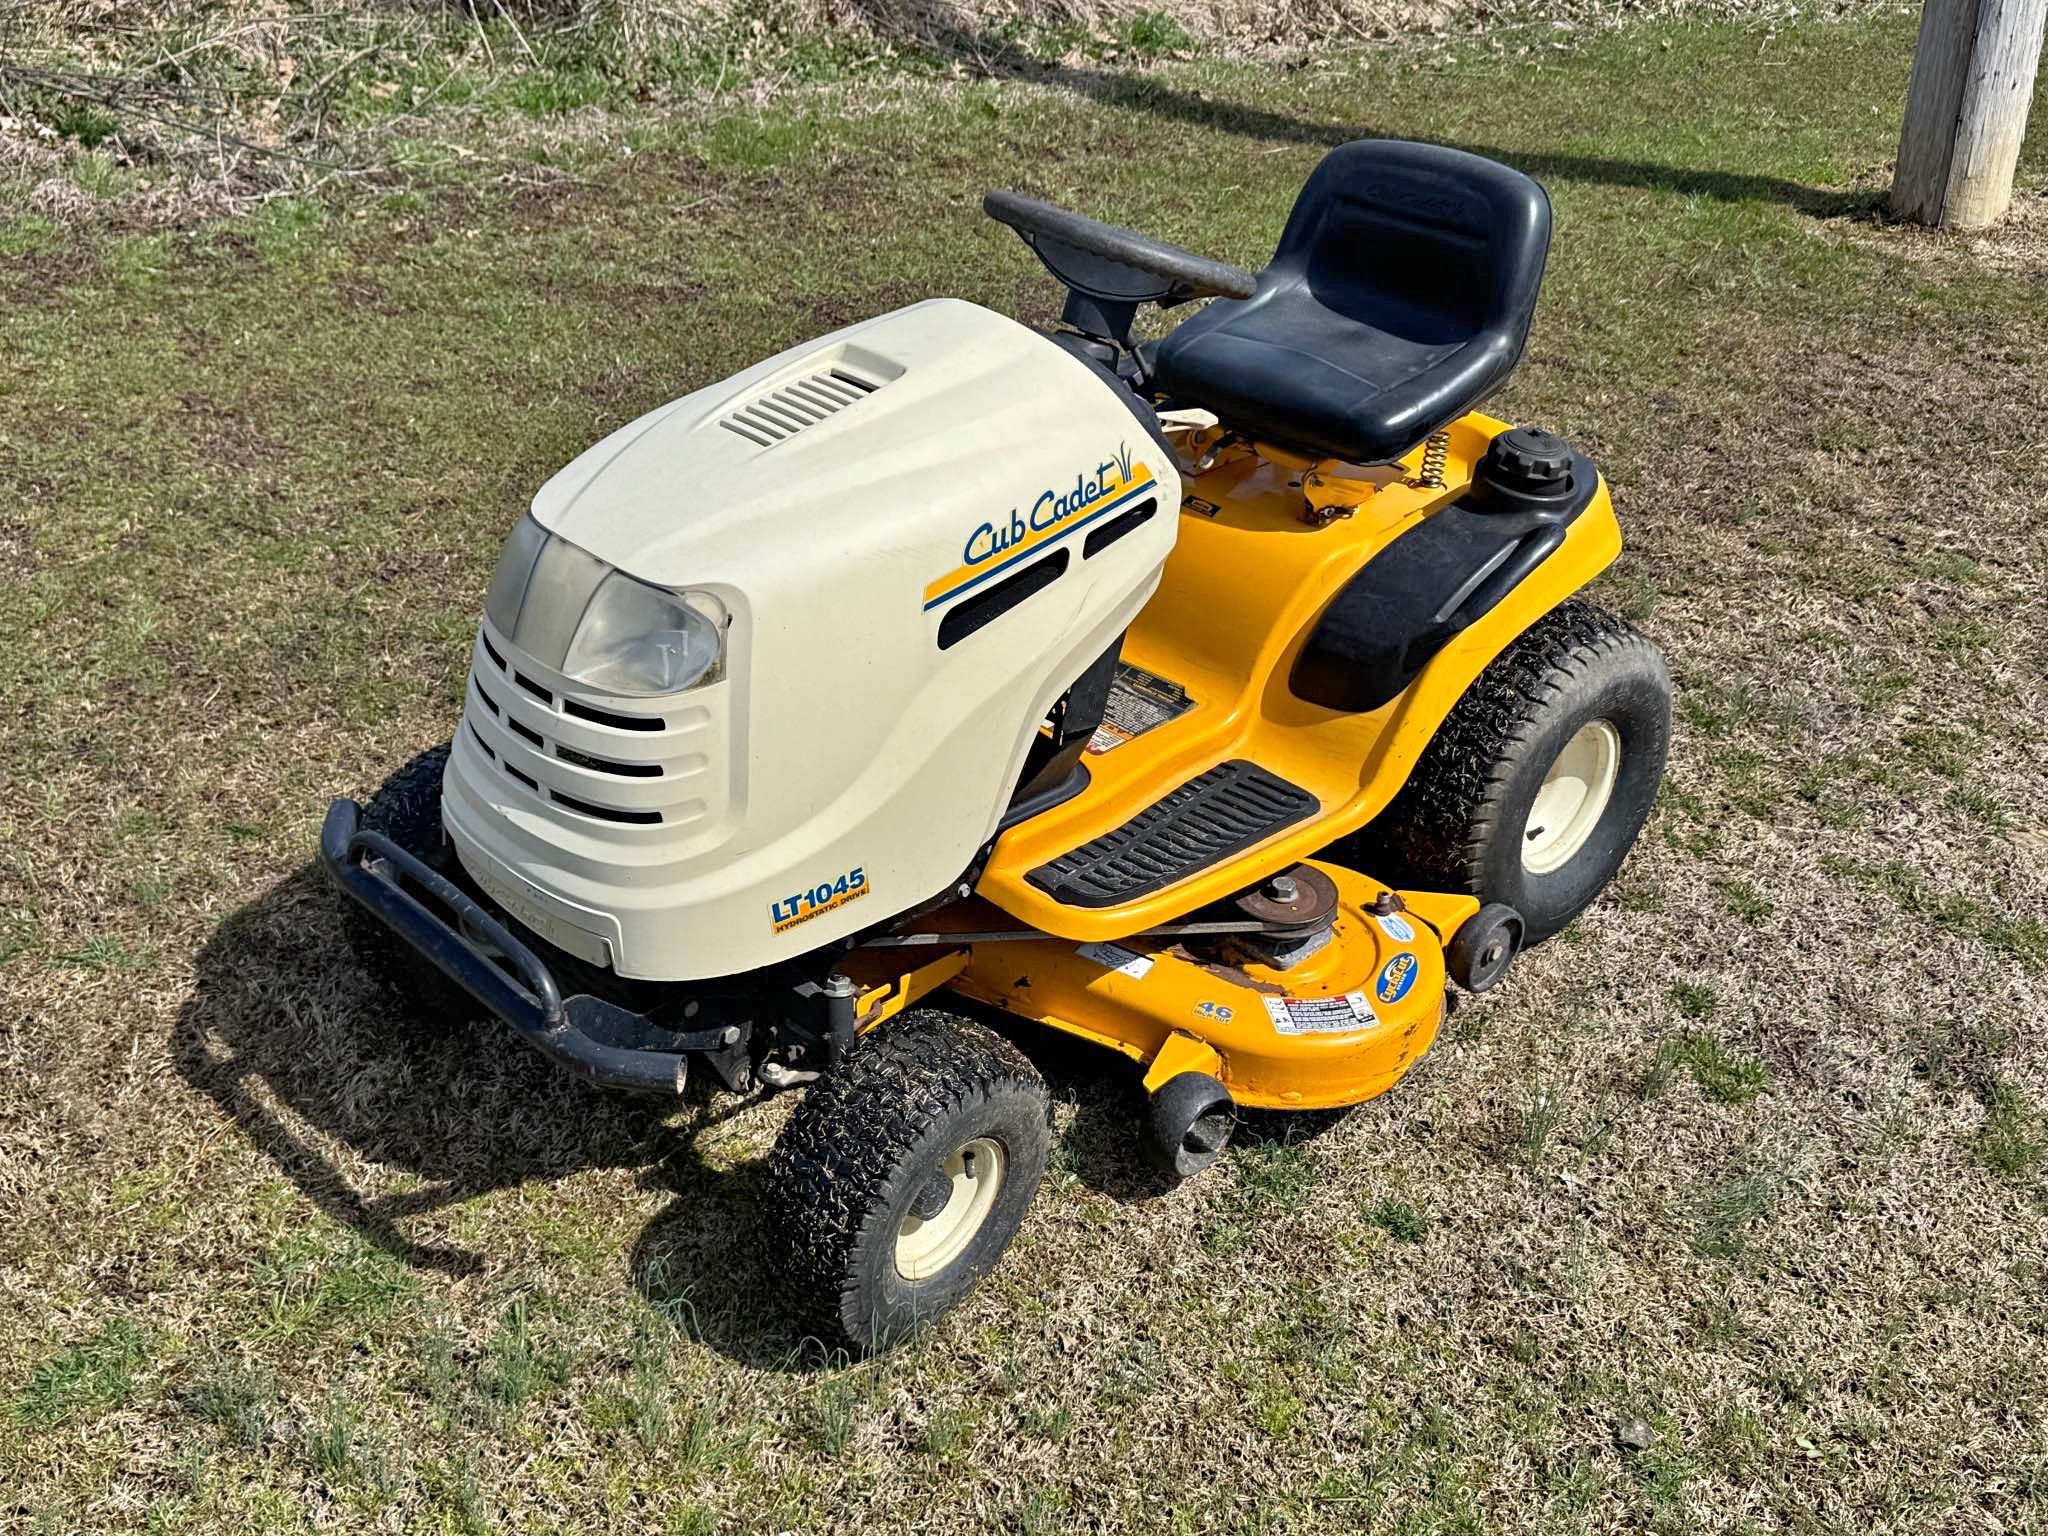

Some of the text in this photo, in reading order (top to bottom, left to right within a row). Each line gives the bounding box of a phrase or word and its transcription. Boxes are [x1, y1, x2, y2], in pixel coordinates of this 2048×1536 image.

[963, 461, 1116, 566] Cub Cadet
[771, 866, 866, 924] LT1045
[775, 887, 867, 934] HYDROSTATIC DRIVE
[1193, 1009, 1231, 1025] INCH CUT
[1197, 1001, 1233, 1019] 46
